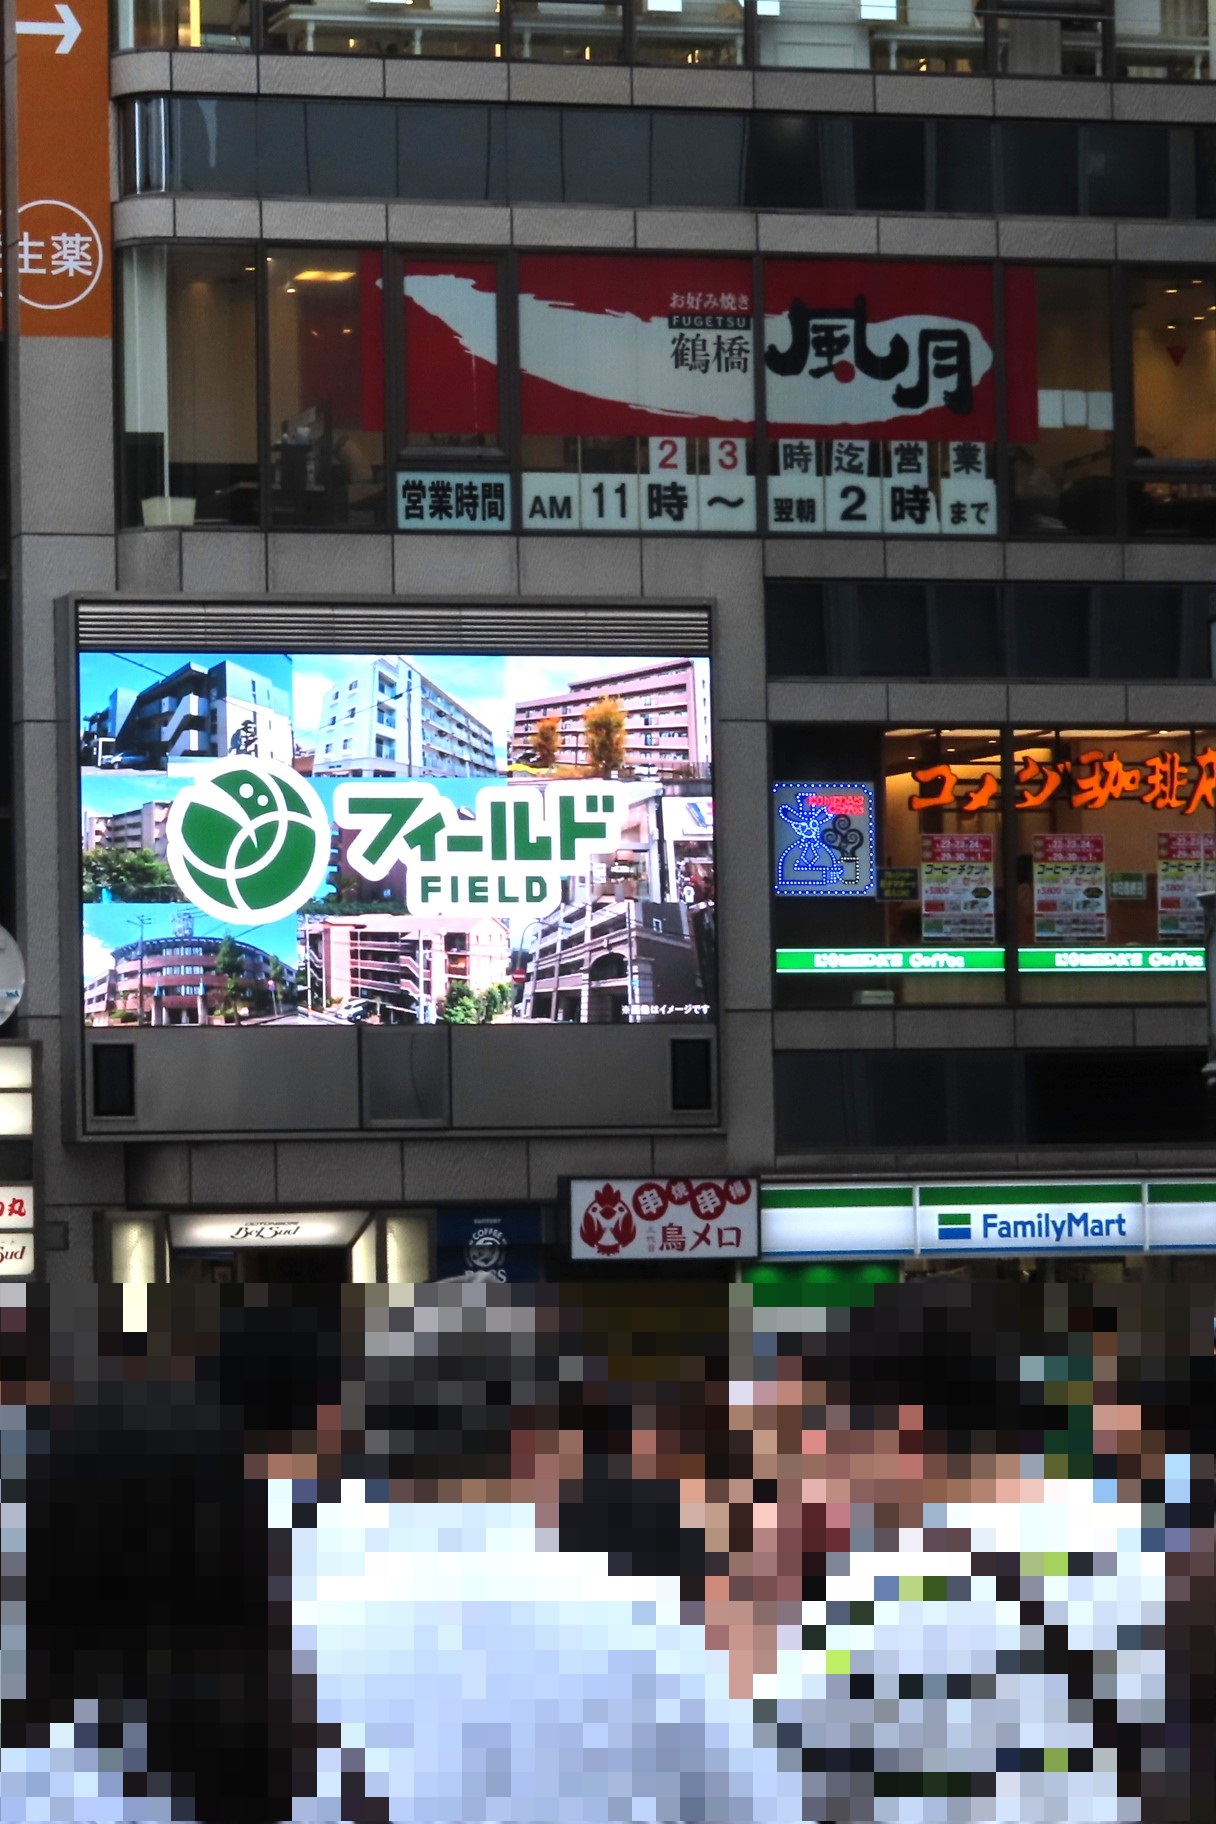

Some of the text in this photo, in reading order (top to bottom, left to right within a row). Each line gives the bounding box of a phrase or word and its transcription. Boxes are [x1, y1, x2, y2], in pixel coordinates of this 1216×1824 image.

[670, 292, 749, 311] お好み焼き
[672, 316, 747, 329] FUGETSU
[670, 294, 973, 414] 鶴橋 風月
[402, 481, 505, 522] 営業時間
[348, 795, 615, 865] フィールド
[421, 876, 548, 903] FIELD
[473, 1227, 503, 1240] COFFEE
[659, 1222, 742, 1252] 鳥メロ
[983, 1212, 1126, 1242] FamilyMart
